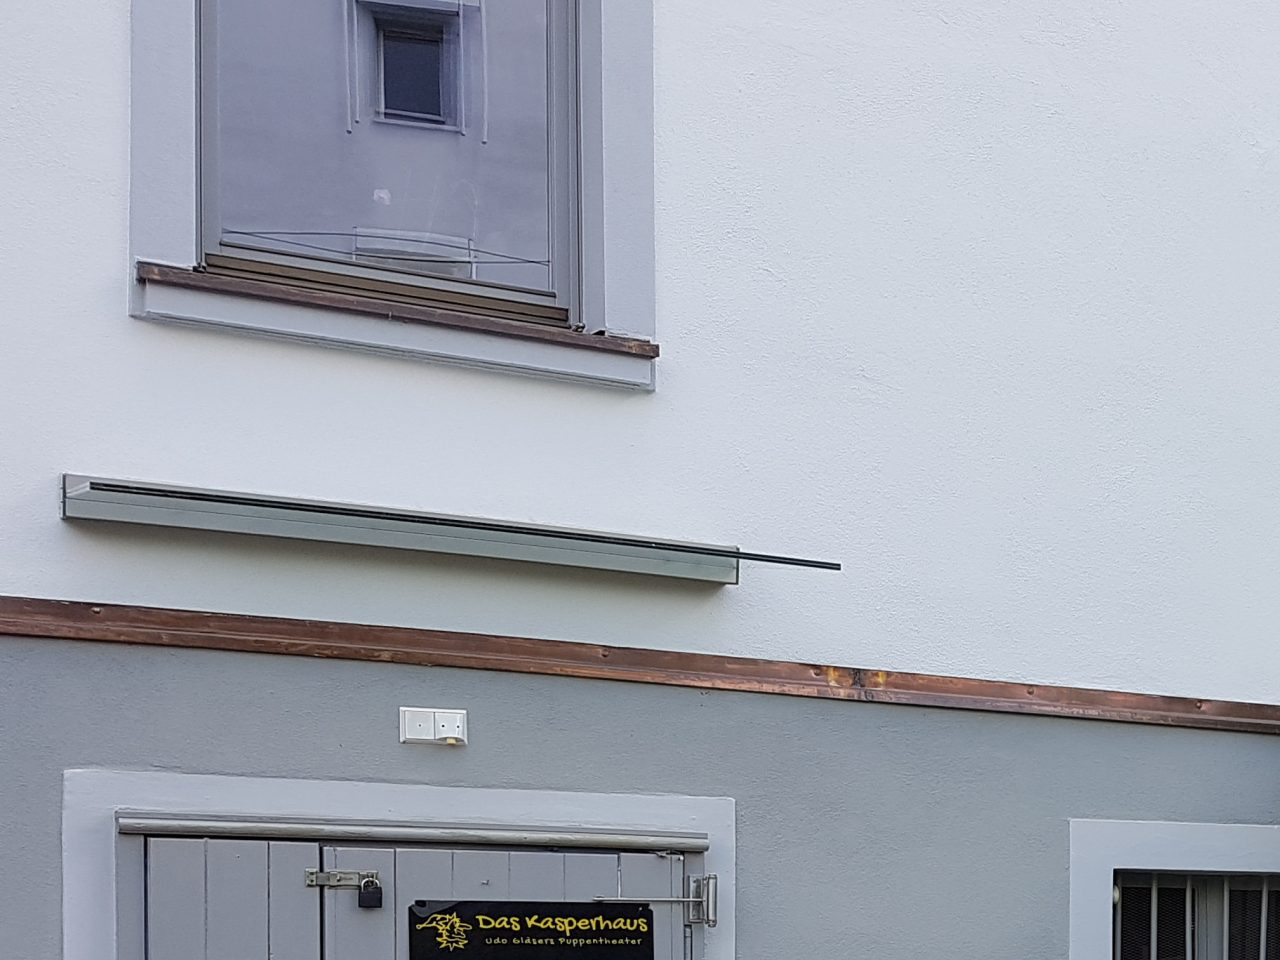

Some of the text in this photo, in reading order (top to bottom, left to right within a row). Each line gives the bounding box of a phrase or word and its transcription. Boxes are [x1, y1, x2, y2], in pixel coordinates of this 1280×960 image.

[475, 914, 648, 936] Das Kasperhaus
[485, 937, 508, 945] Udo
[558, 937, 643, 947] Puppentheater
